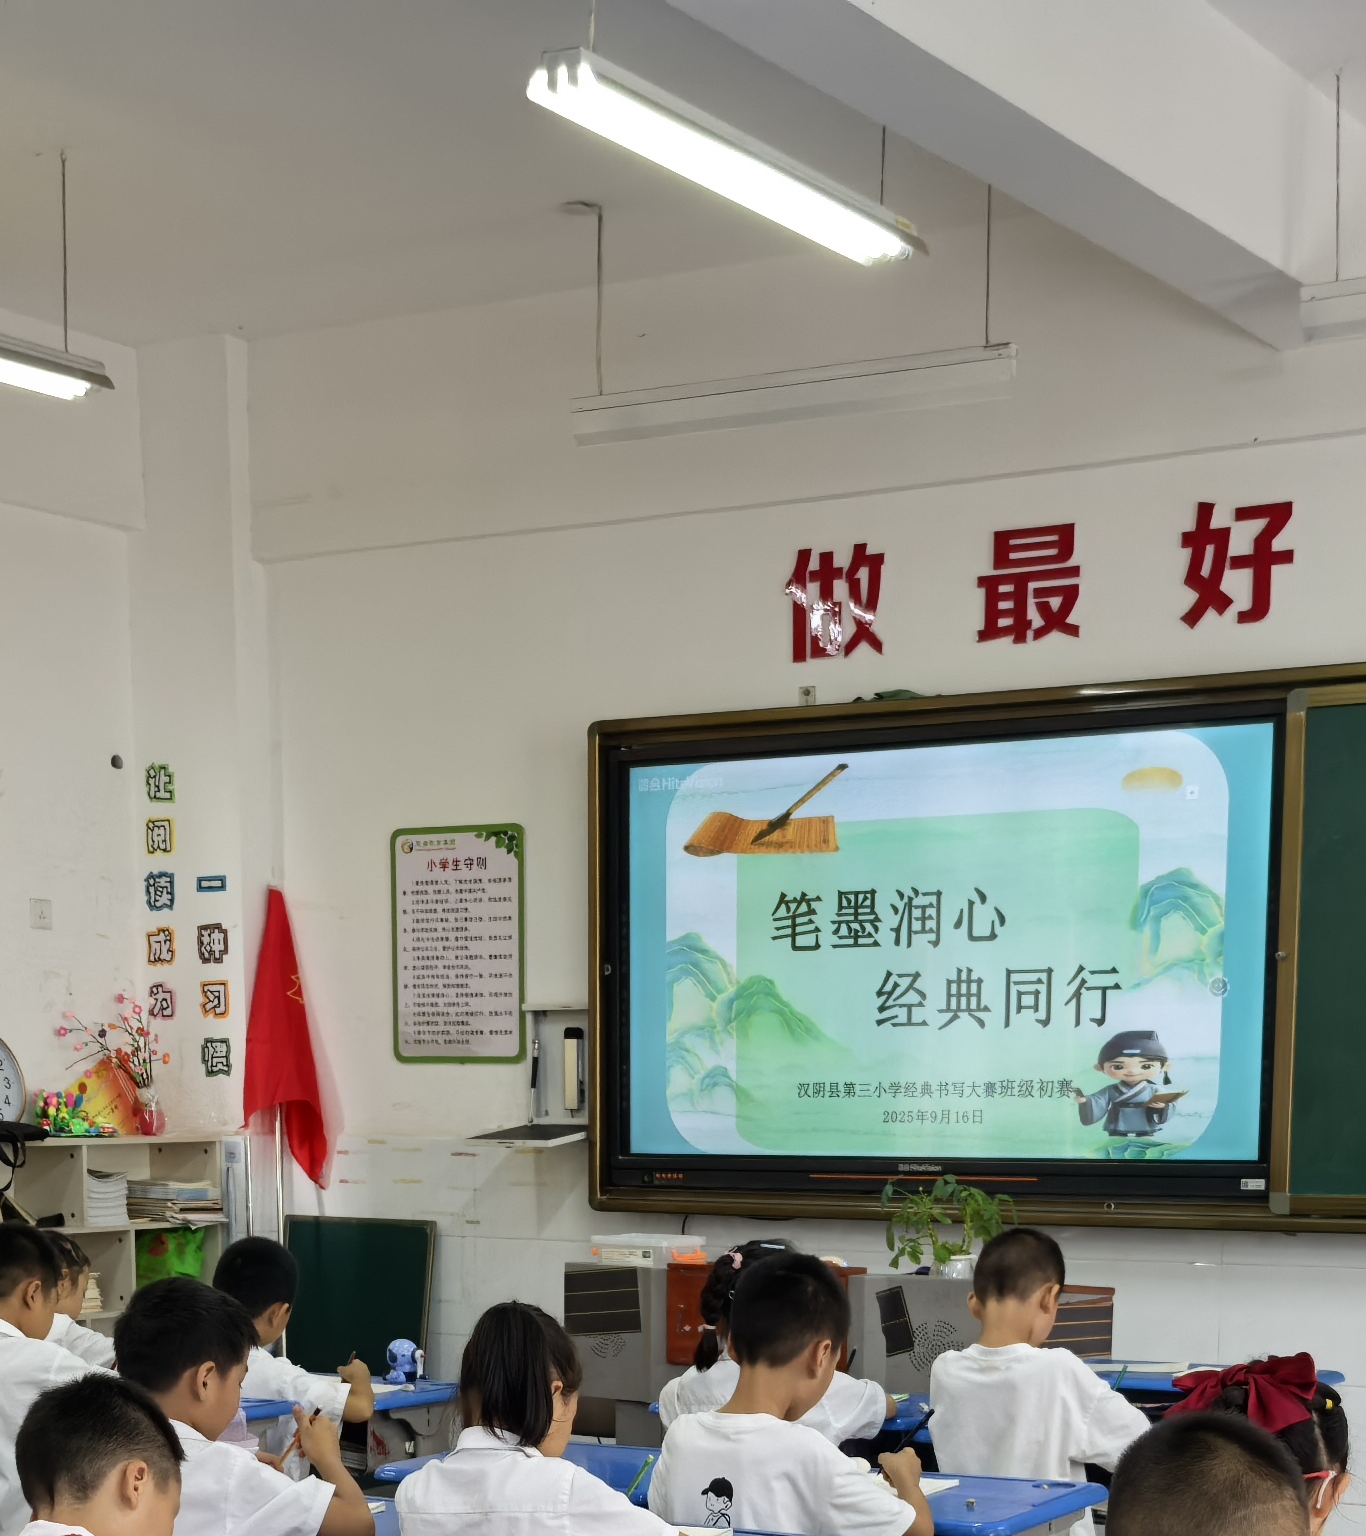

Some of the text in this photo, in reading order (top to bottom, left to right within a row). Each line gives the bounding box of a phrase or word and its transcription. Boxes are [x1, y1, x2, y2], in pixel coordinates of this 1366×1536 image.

[427, 856, 487, 873] 小学生守则
[144, 762, 177, 1020] 让阅读成为
[770, 886, 1007, 953] 笔墨润心
[196, 875, 232, 1078] 一种习惯
[875, 963, 1123, 1031] 经典同行
[3, 1077, 11, 1089] 3
[796, 1077, 1075, 1100] 汉阴县第三小学经典书写大赛班级初赛
[4, 1095, 11, 1107] 4
[882, 1109, 985, 1127] 2025年9月16日
